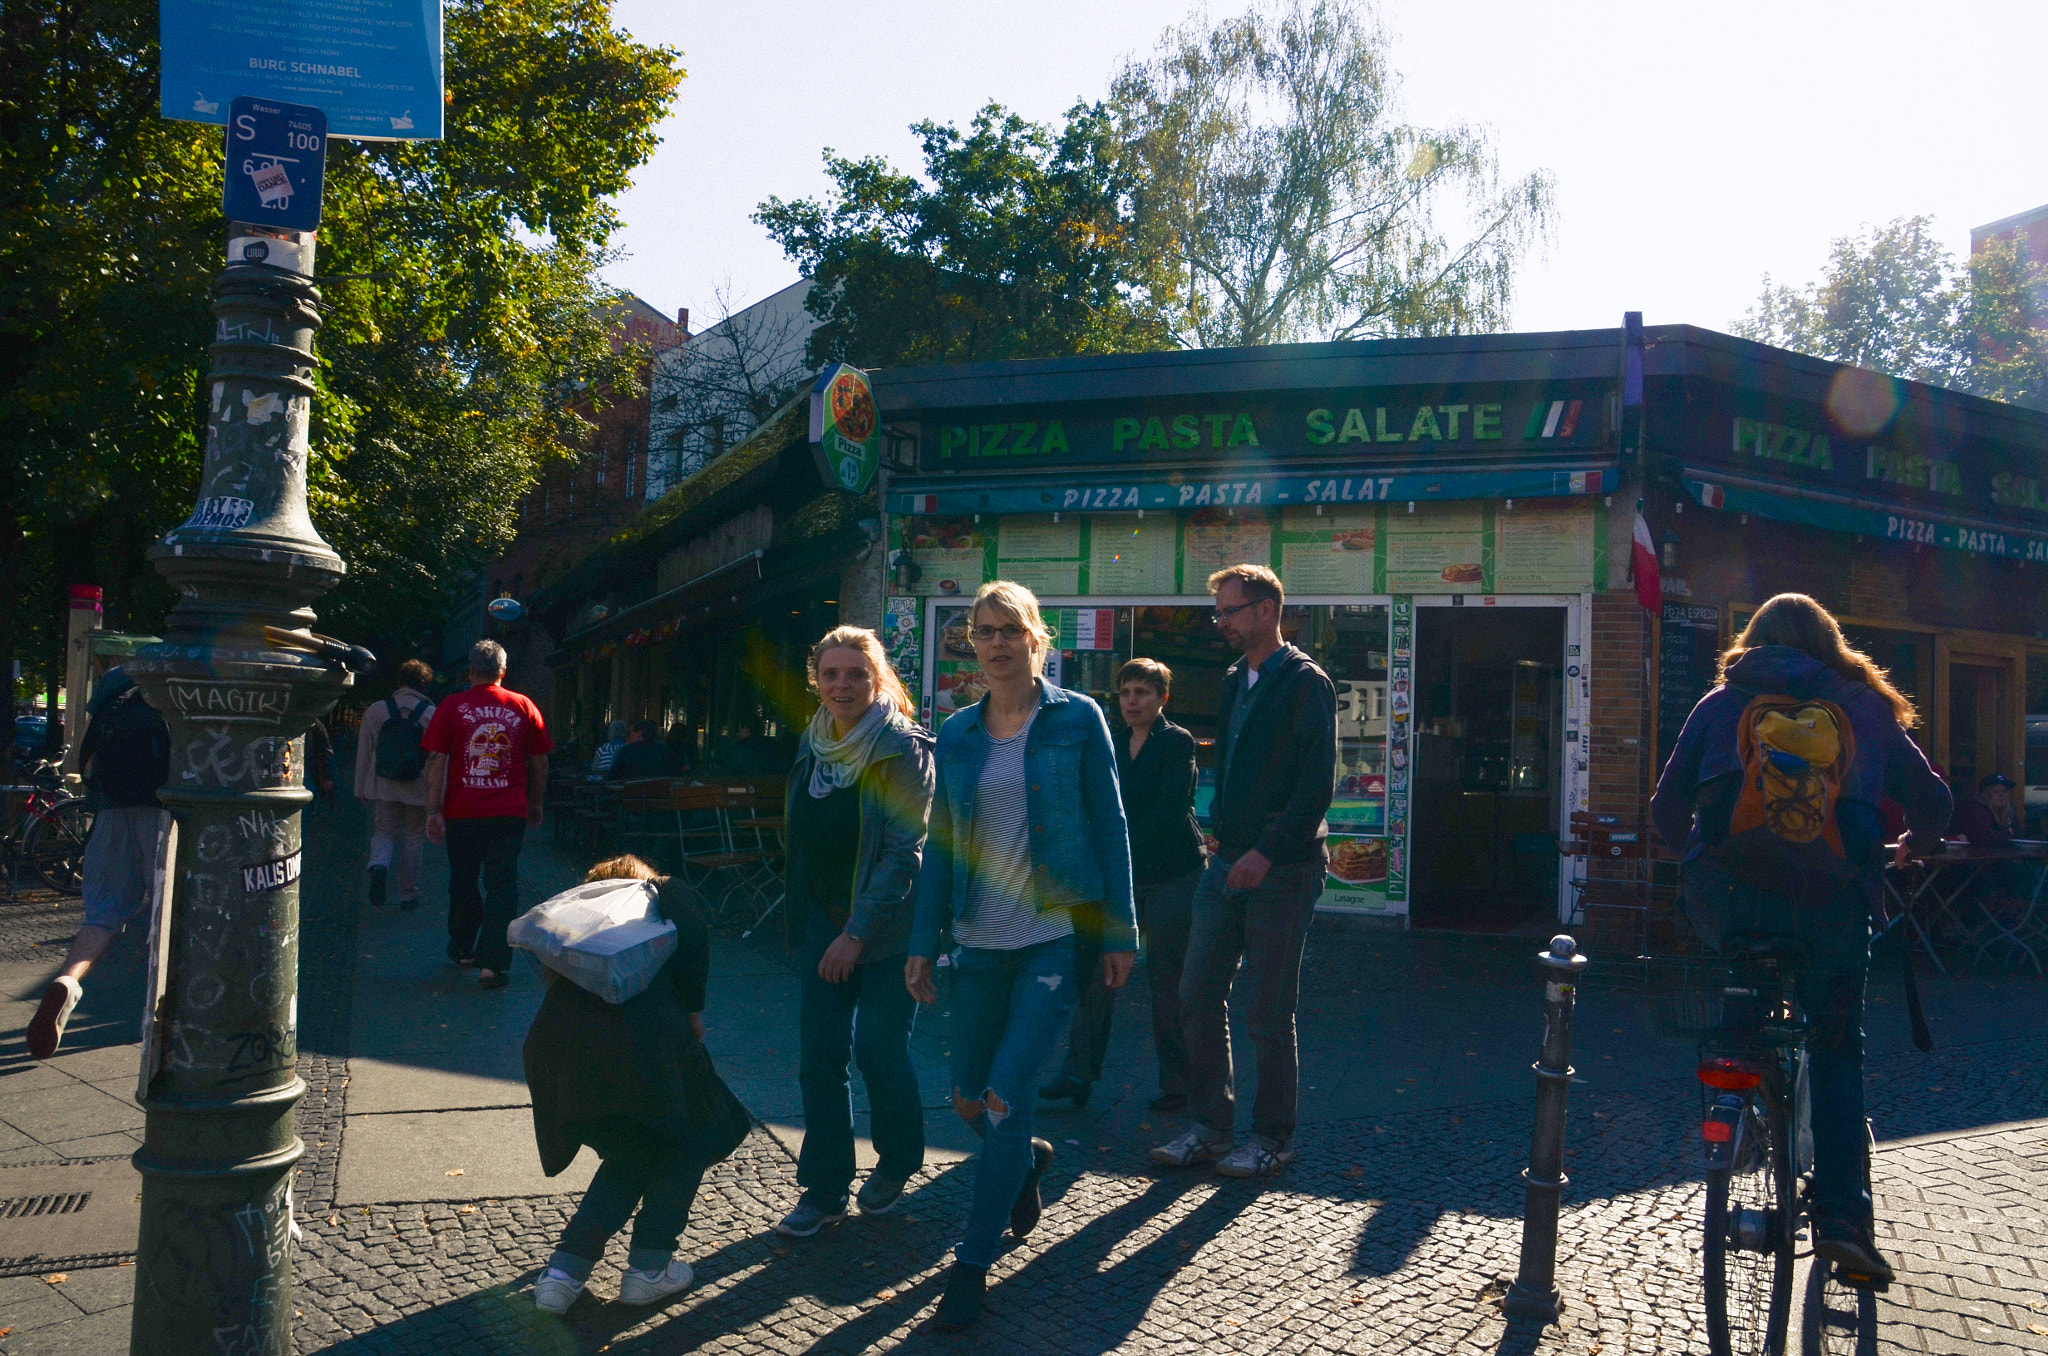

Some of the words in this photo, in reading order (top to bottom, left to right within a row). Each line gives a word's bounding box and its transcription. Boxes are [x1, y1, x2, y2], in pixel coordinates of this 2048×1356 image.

[249, 57, 287, 71] BURG
[290, 62, 362, 79] SCHNABEL
[252, 104, 281, 115] Wasser
[235, 114, 257, 141] S
[287, 131, 320, 152] 100
[940, 420, 1070, 460] PIZZA
[1112, 412, 1260, 451] PASTA
[1305, 402, 1504, 446] SALATE
[838, 437, 862, 458] Pizza
[1733, 416, 1834, 471] PIZZA
[1866, 446, 1963, 496] PASTA
[1063, 486, 1139, 509] PIZZA
[1179, 481, 1262, 506] PASTA
[1306, 477, 1394, 502] SALAT
[1886, 515, 1935, 545] PIZZA
[1958, 527, 2006, 556] PASTA
[462, 705, 522, 728] YAKUZA
[462, 776, 509, 788] VERANO
[243, 860, 285, 893] KALIS
[1334, 893, 1365, 905] Lasagne
